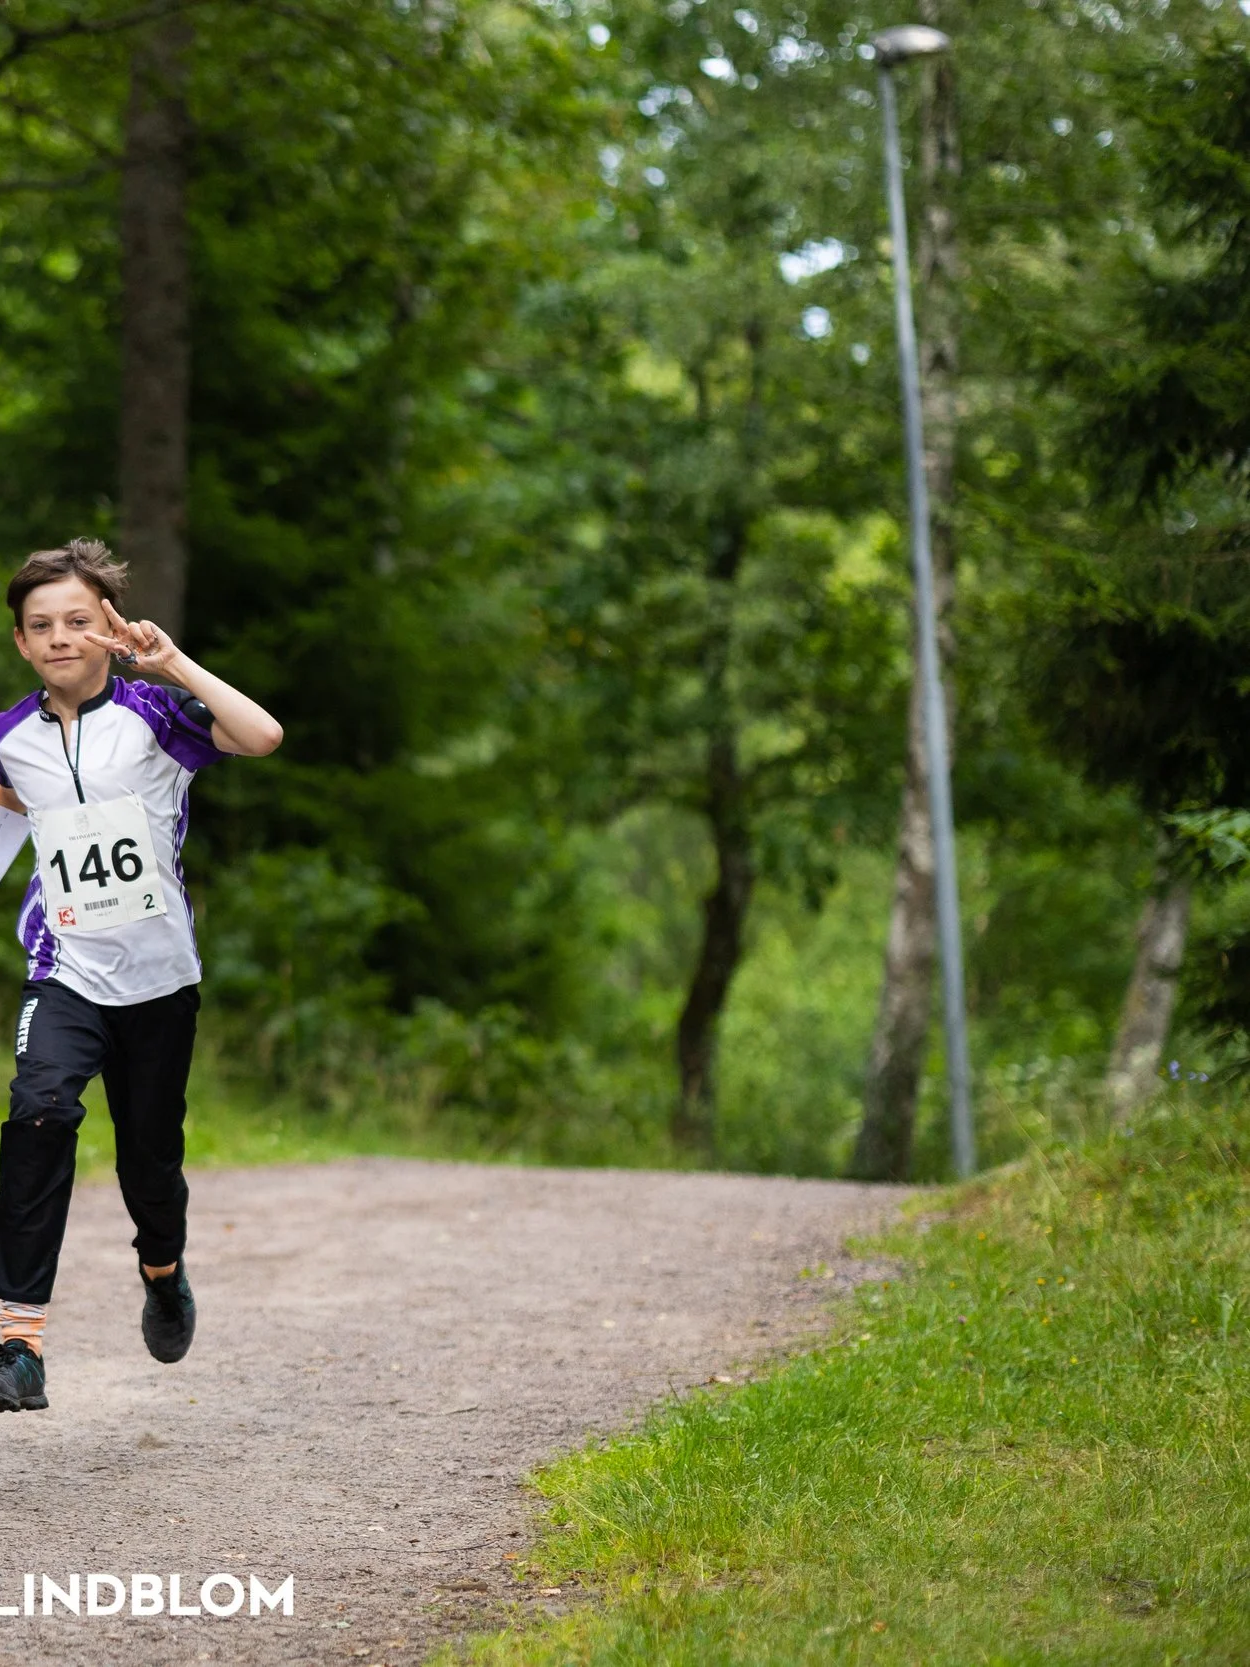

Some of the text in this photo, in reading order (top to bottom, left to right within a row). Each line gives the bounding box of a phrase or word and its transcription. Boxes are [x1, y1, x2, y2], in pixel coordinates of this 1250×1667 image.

[50, 838, 144, 893] 146
[143, 894, 155, 909] 2
[16, 998, 38, 1055] TRIMTEX
